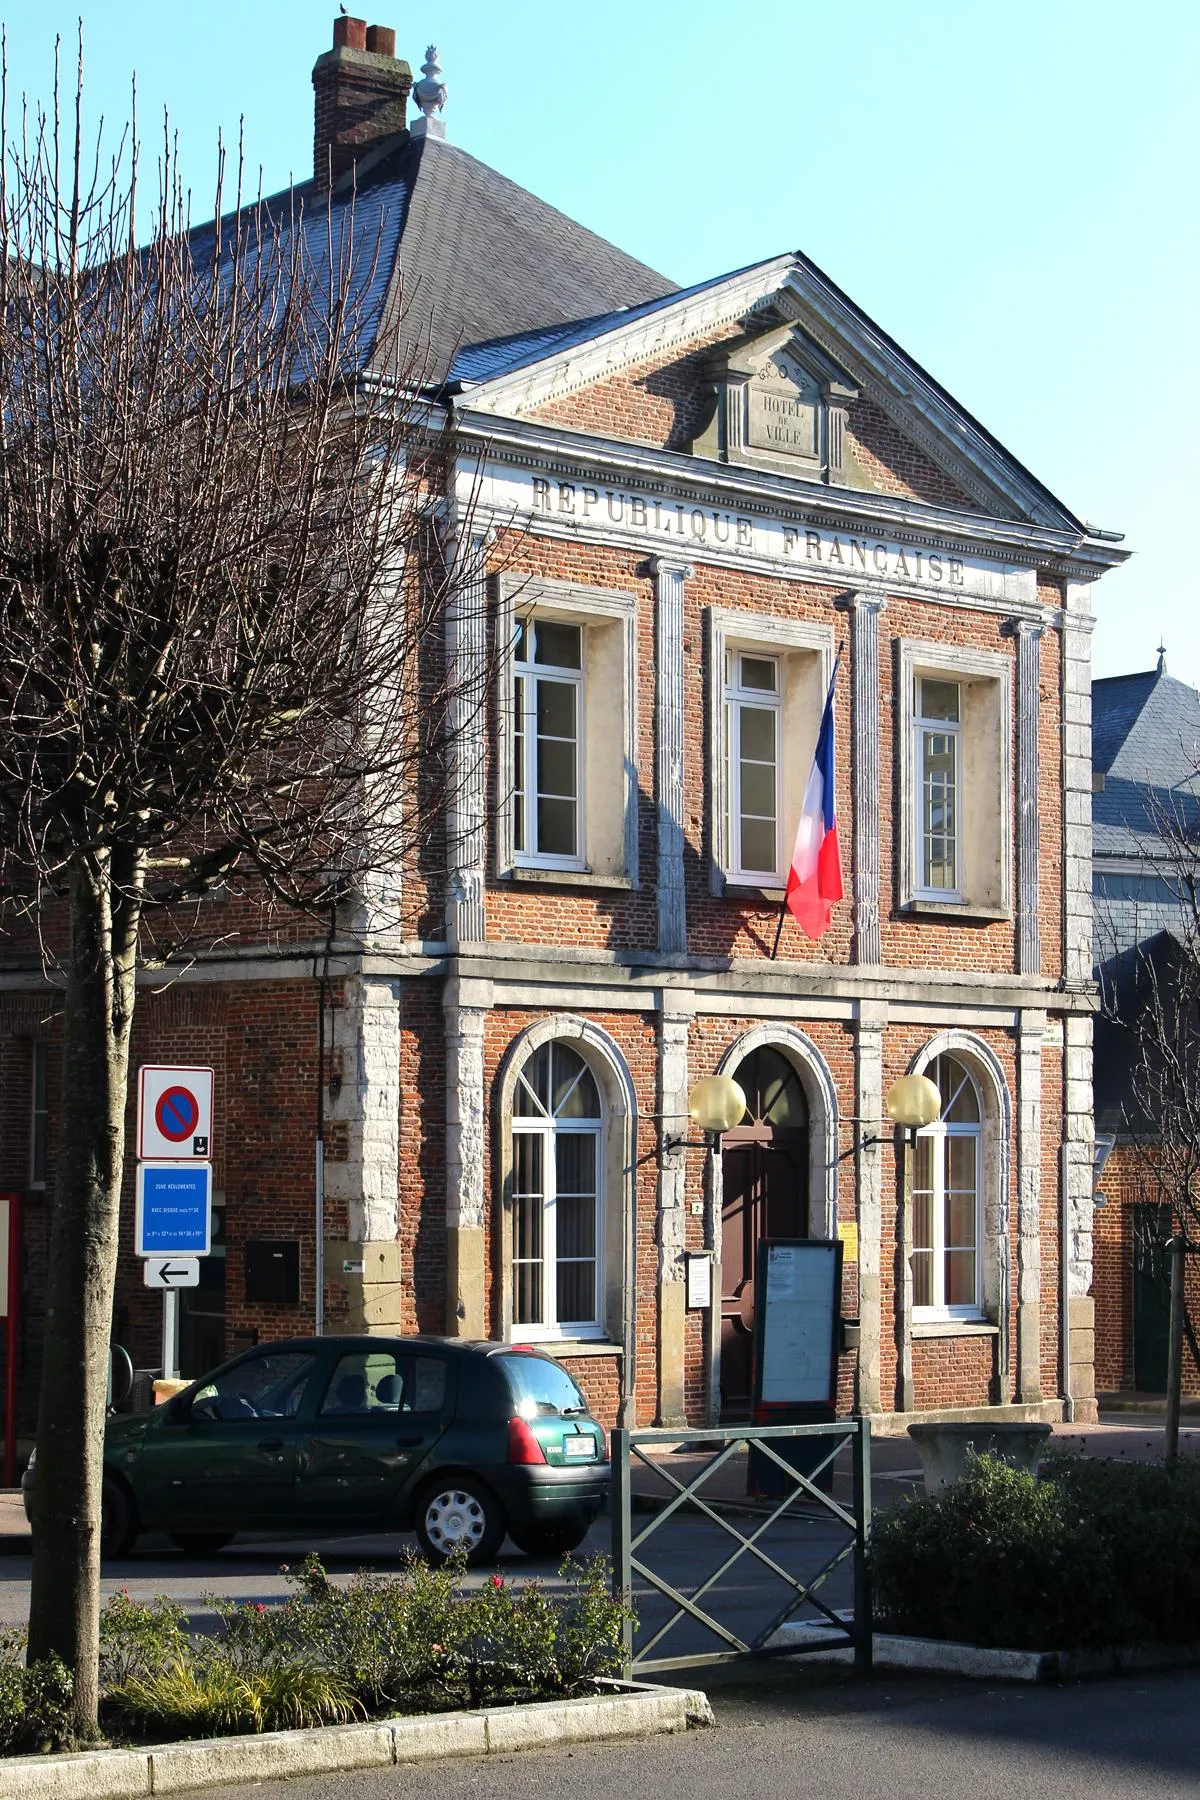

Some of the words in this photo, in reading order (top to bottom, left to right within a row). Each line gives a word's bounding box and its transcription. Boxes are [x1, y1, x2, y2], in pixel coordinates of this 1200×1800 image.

[779, 416, 790, 425] DE
[766, 425, 801, 445] VILLE
[781, 525, 965, 587] FRANÇAISE
